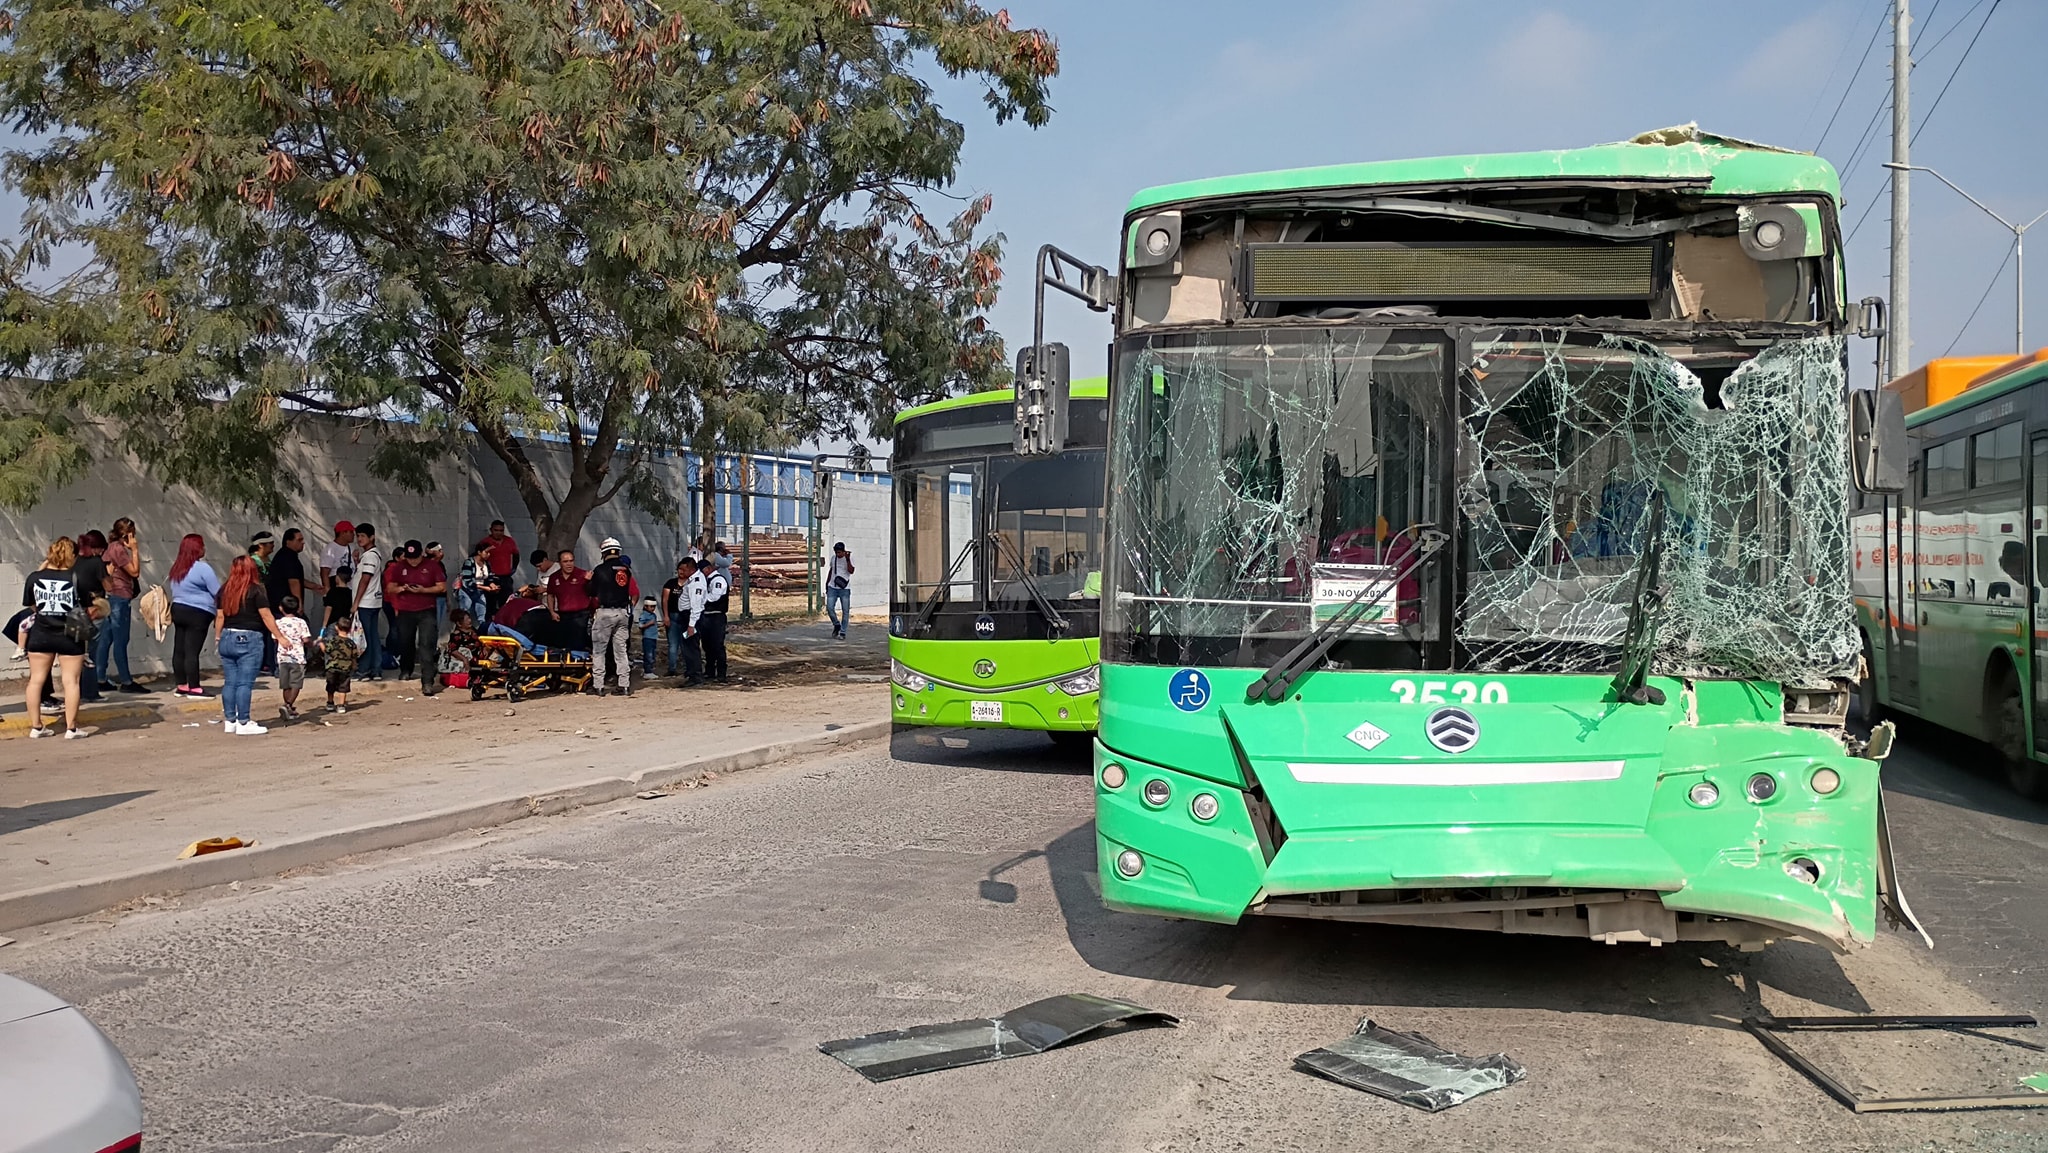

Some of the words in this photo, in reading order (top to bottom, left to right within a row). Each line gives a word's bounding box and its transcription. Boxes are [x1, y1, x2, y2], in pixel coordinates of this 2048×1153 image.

[35, 589, 72, 604] CHOPPERS
[975, 622, 995, 632] 0443
[1354, 730, 1382, 742] CNG
